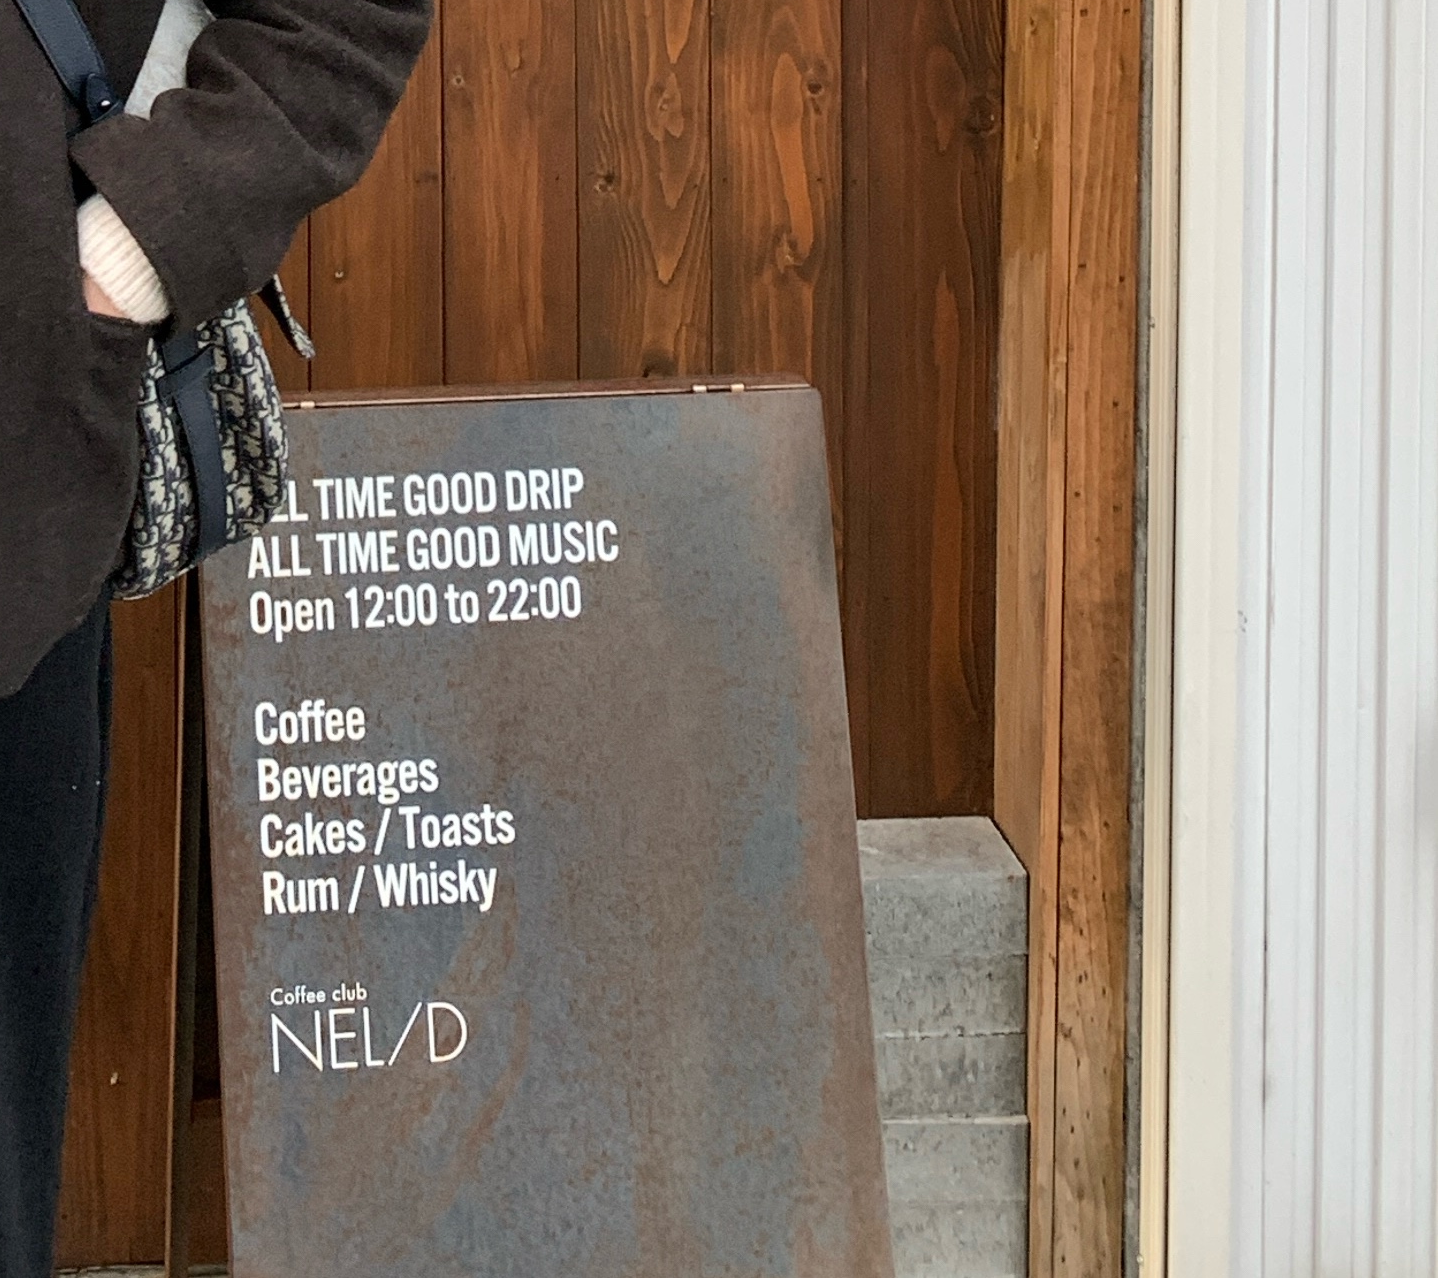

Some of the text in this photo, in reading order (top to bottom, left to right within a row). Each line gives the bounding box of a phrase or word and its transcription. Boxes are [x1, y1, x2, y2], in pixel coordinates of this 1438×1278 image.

[312, 475, 397, 521] TIME
[403, 471, 497, 517] GOOD
[505, 467, 584, 512] DRIP
[247, 519, 619, 579] ALL TIME GOOD MUSIC
[249, 575, 582, 643] Open 12:00 to 22:00
[254, 698, 366, 746] Coffee
[257, 758, 439, 805] Beverages
[260, 812, 367, 858] Cakes
[398, 803, 516, 850] Toasts
[262, 870, 340, 915] Rum
[372, 859, 497, 913] Whisky
[270, 981, 368, 1006] Coffee club
[270, 1001, 468, 1074] NEL/D
